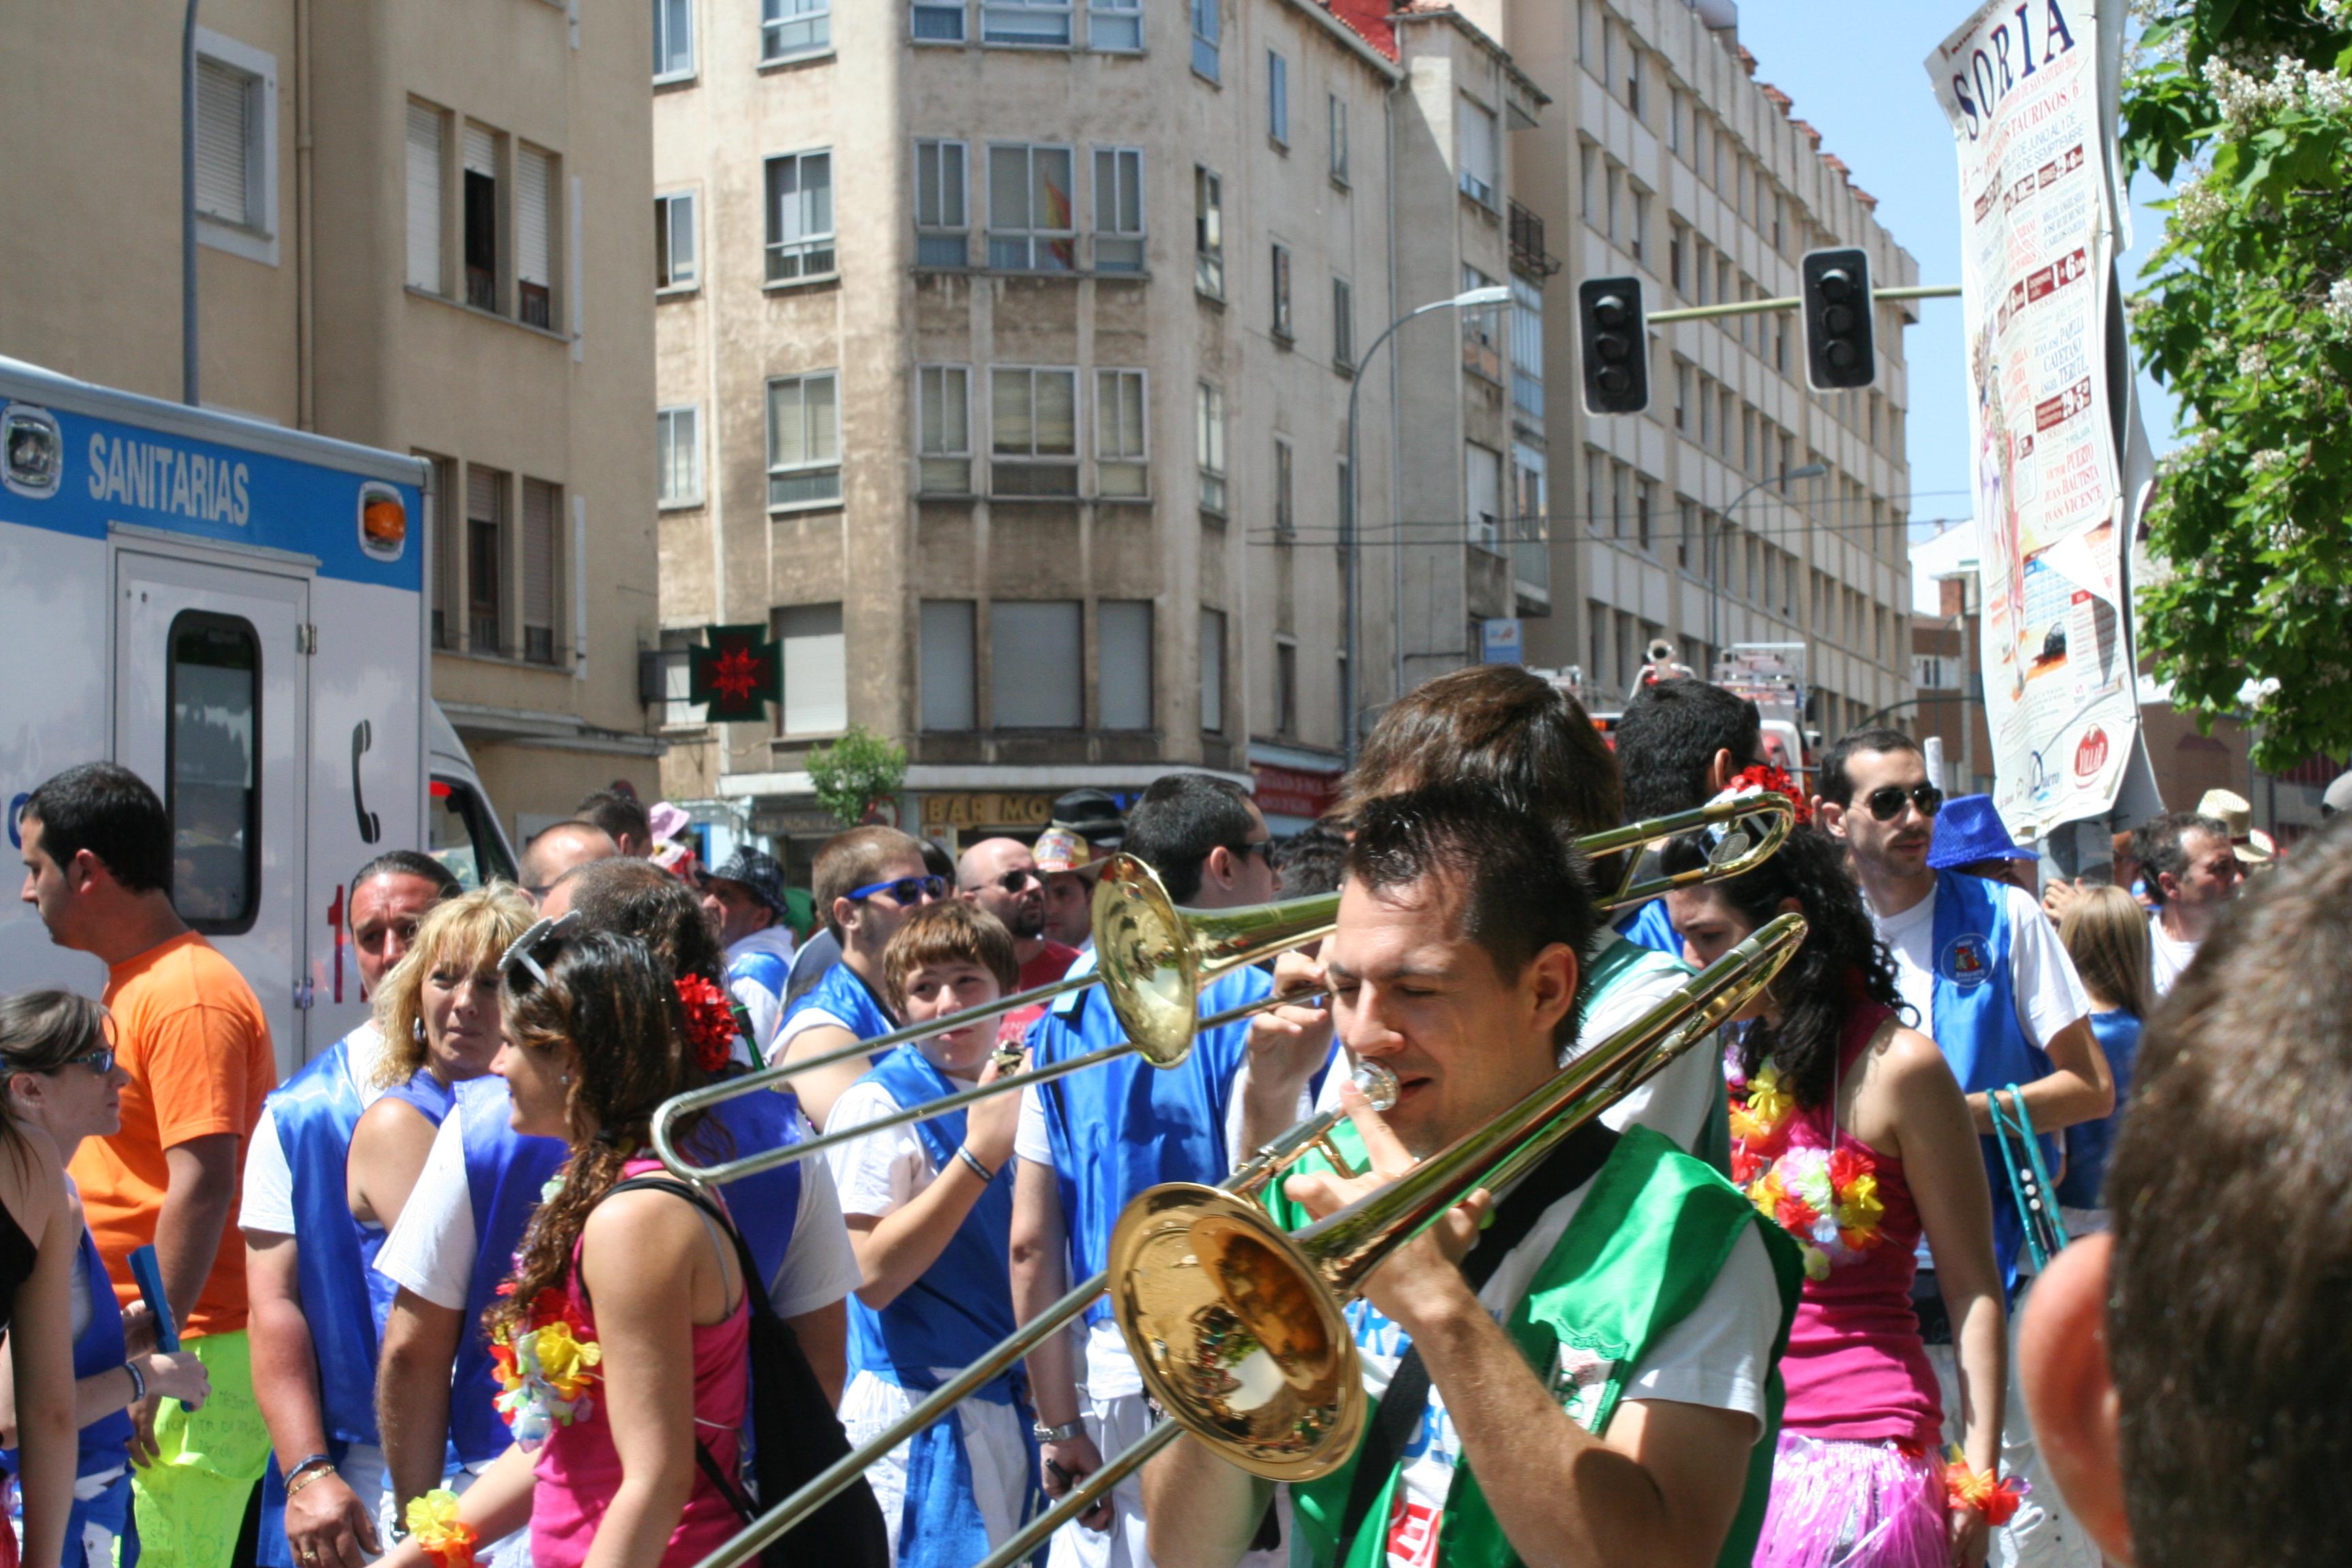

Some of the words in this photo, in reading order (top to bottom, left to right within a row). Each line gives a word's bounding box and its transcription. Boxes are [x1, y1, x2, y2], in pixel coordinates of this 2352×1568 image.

[1952, 0, 2074, 141] SORIA
[2065, 254, 2076, 280] 6
[88, 432, 249, 527] SANITARIAS
[928, 796, 987, 822] BAR
[1003, 794, 1049, 823] MO
